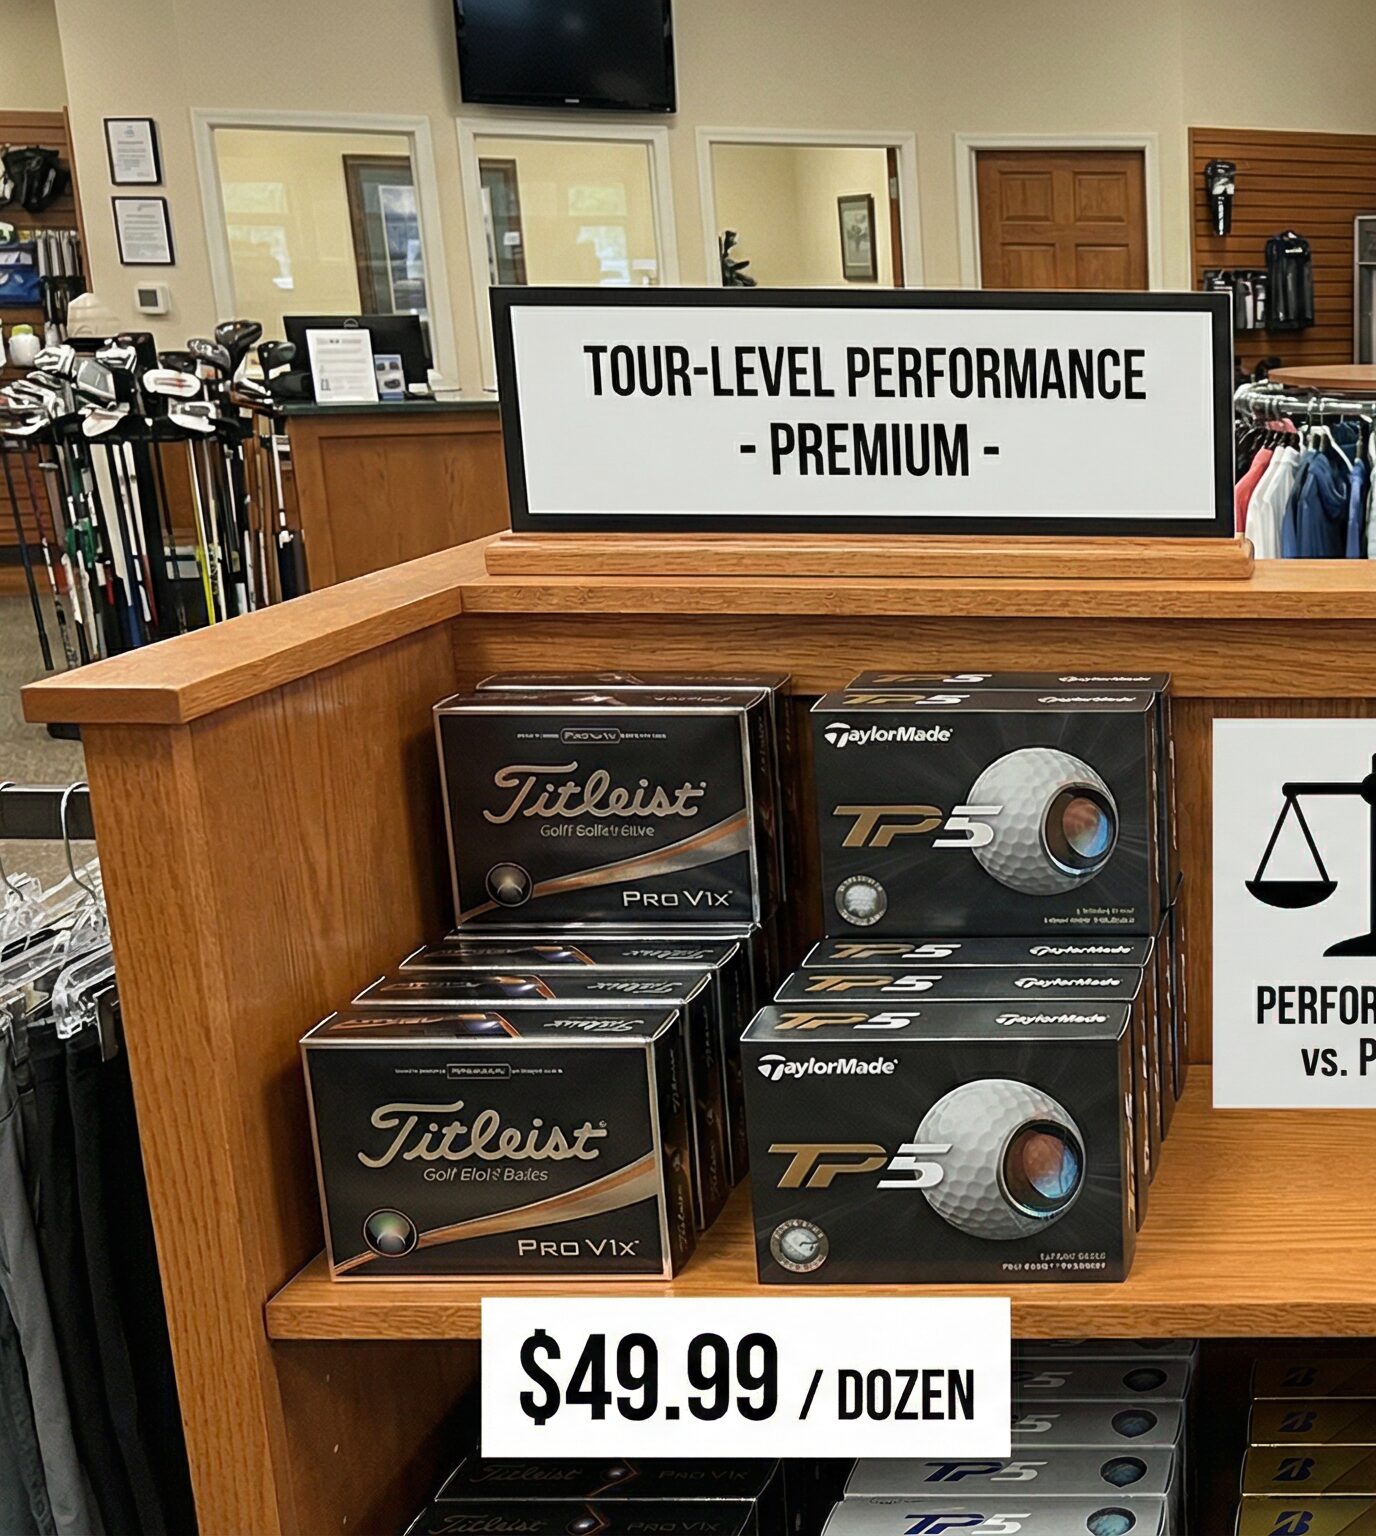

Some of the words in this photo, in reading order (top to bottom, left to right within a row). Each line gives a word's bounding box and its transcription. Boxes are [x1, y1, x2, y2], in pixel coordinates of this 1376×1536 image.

[584, 345, 834, 398] TOUR-LEVEL
[847, 347, 1146, 400] PERFORMANCE
[771, 423, 968, 476] PREMIUM
[824, 722, 954, 748] TaylorMade
[483, 761, 706, 824] Titleist
[833, 805, 1003, 848] TP5
[623, 890, 678, 906] PRO
[804, 975, 943, 992] TP5
[774, 1012, 921, 1030] TP5
[757, 1054, 899, 1081] TaylorMade
[1301, 1048, 1347, 1076] vs.
[358, 1100, 607, 1168] Titleist
[768, 1143, 953, 1189] TP5
[518, 1239, 579, 1256] PRO
[520, 1328, 777, 1425] $49.99
[799, 1370, 823, 1420] /
[839, 1369, 973, 1420] DOZEN
[924, 1461, 1048, 1482] TP5
[904, 1513, 1032, 1536] TP5
